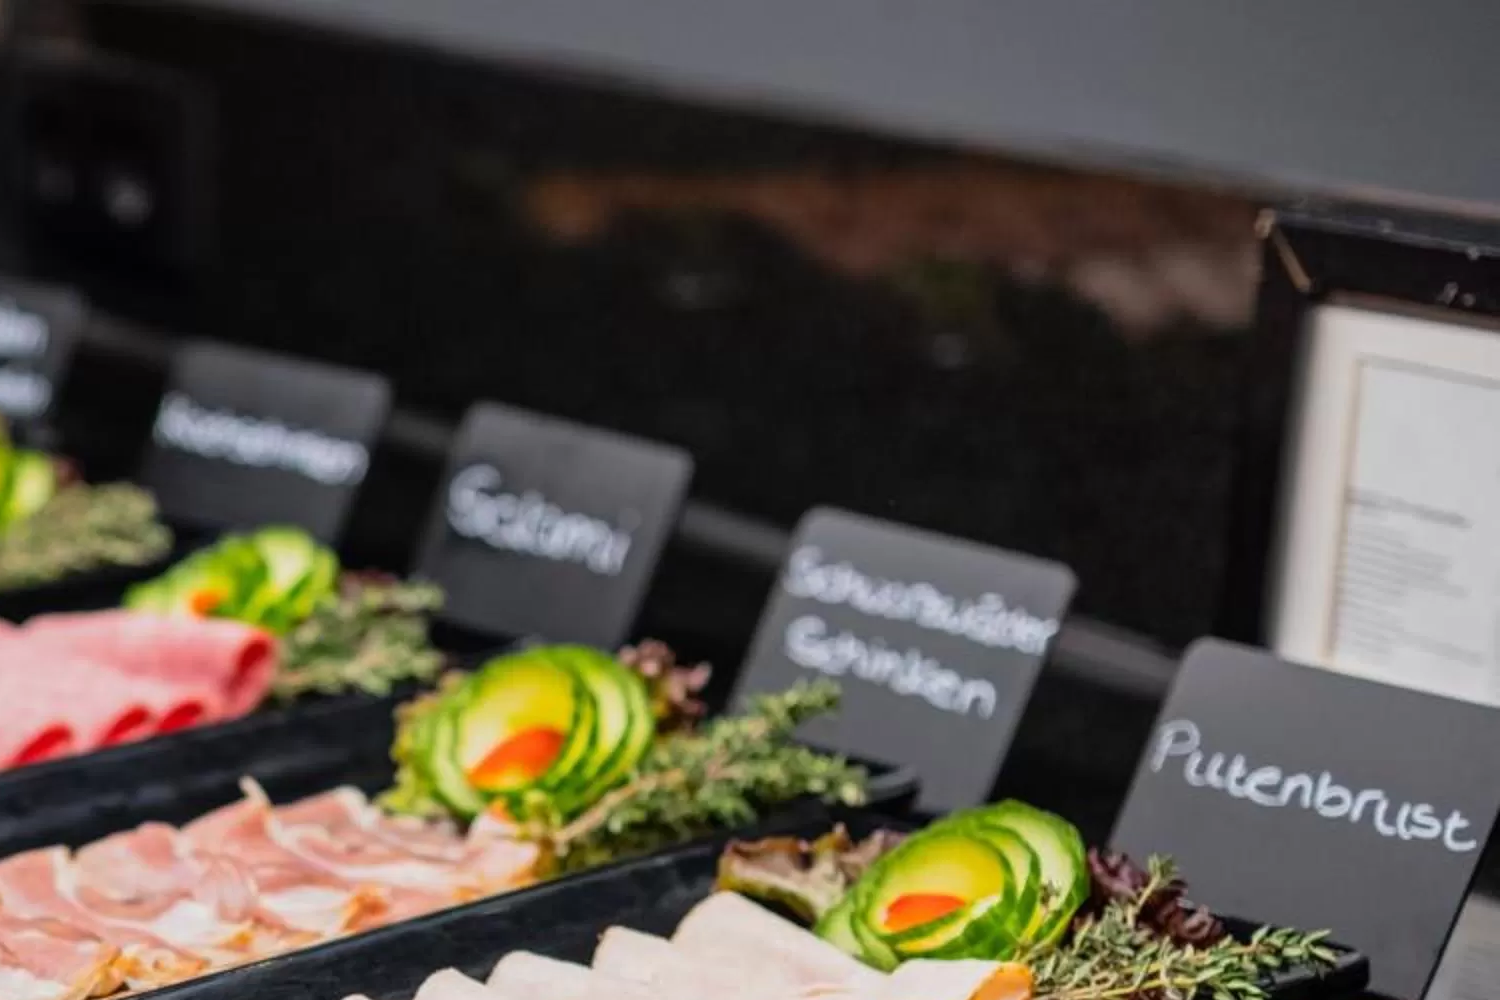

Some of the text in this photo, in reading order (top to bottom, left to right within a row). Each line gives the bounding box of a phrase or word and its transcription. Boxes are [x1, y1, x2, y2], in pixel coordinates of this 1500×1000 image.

[448, 463, 640, 576] Salami
[785, 614, 997, 720] Schinken
[1151, 718, 1477, 852] Putenbrust
